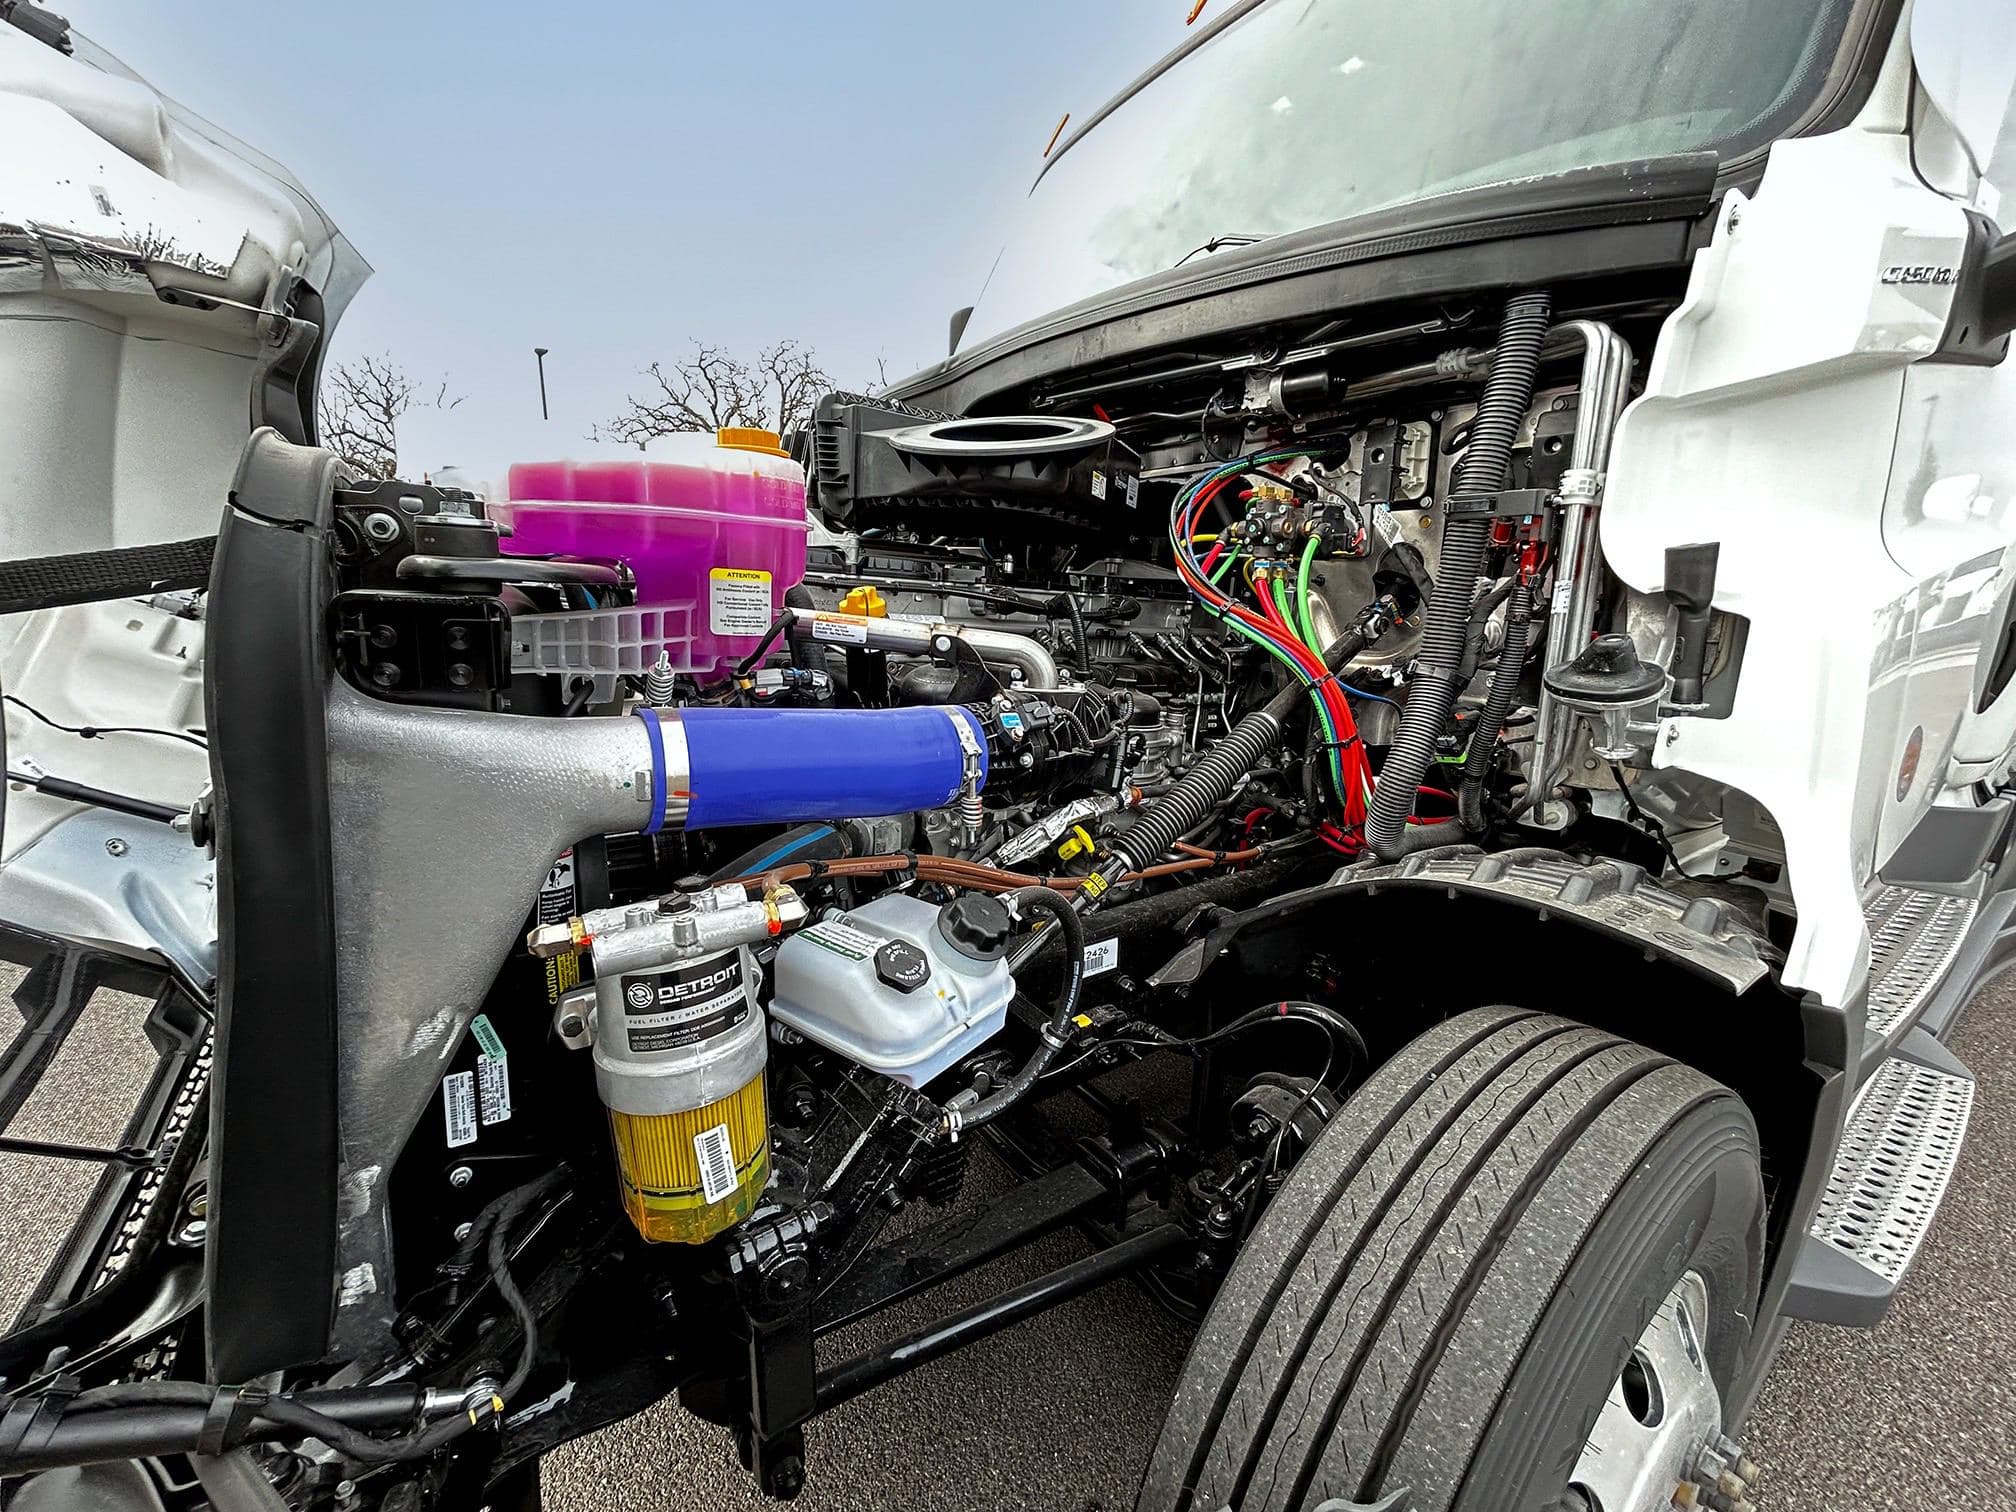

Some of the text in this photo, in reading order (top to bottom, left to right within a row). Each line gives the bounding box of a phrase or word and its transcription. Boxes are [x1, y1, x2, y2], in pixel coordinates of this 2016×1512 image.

[1091, 873, 1107, 888] STEP
[1086, 946, 1109, 960] 2426
[658, 961, 740, 1000] DETROIT
[649, 1015, 675, 1023] FILTER
[685, 1006, 709, 1016] WATER
[712, 988, 742, 1009] SEPARATOR
